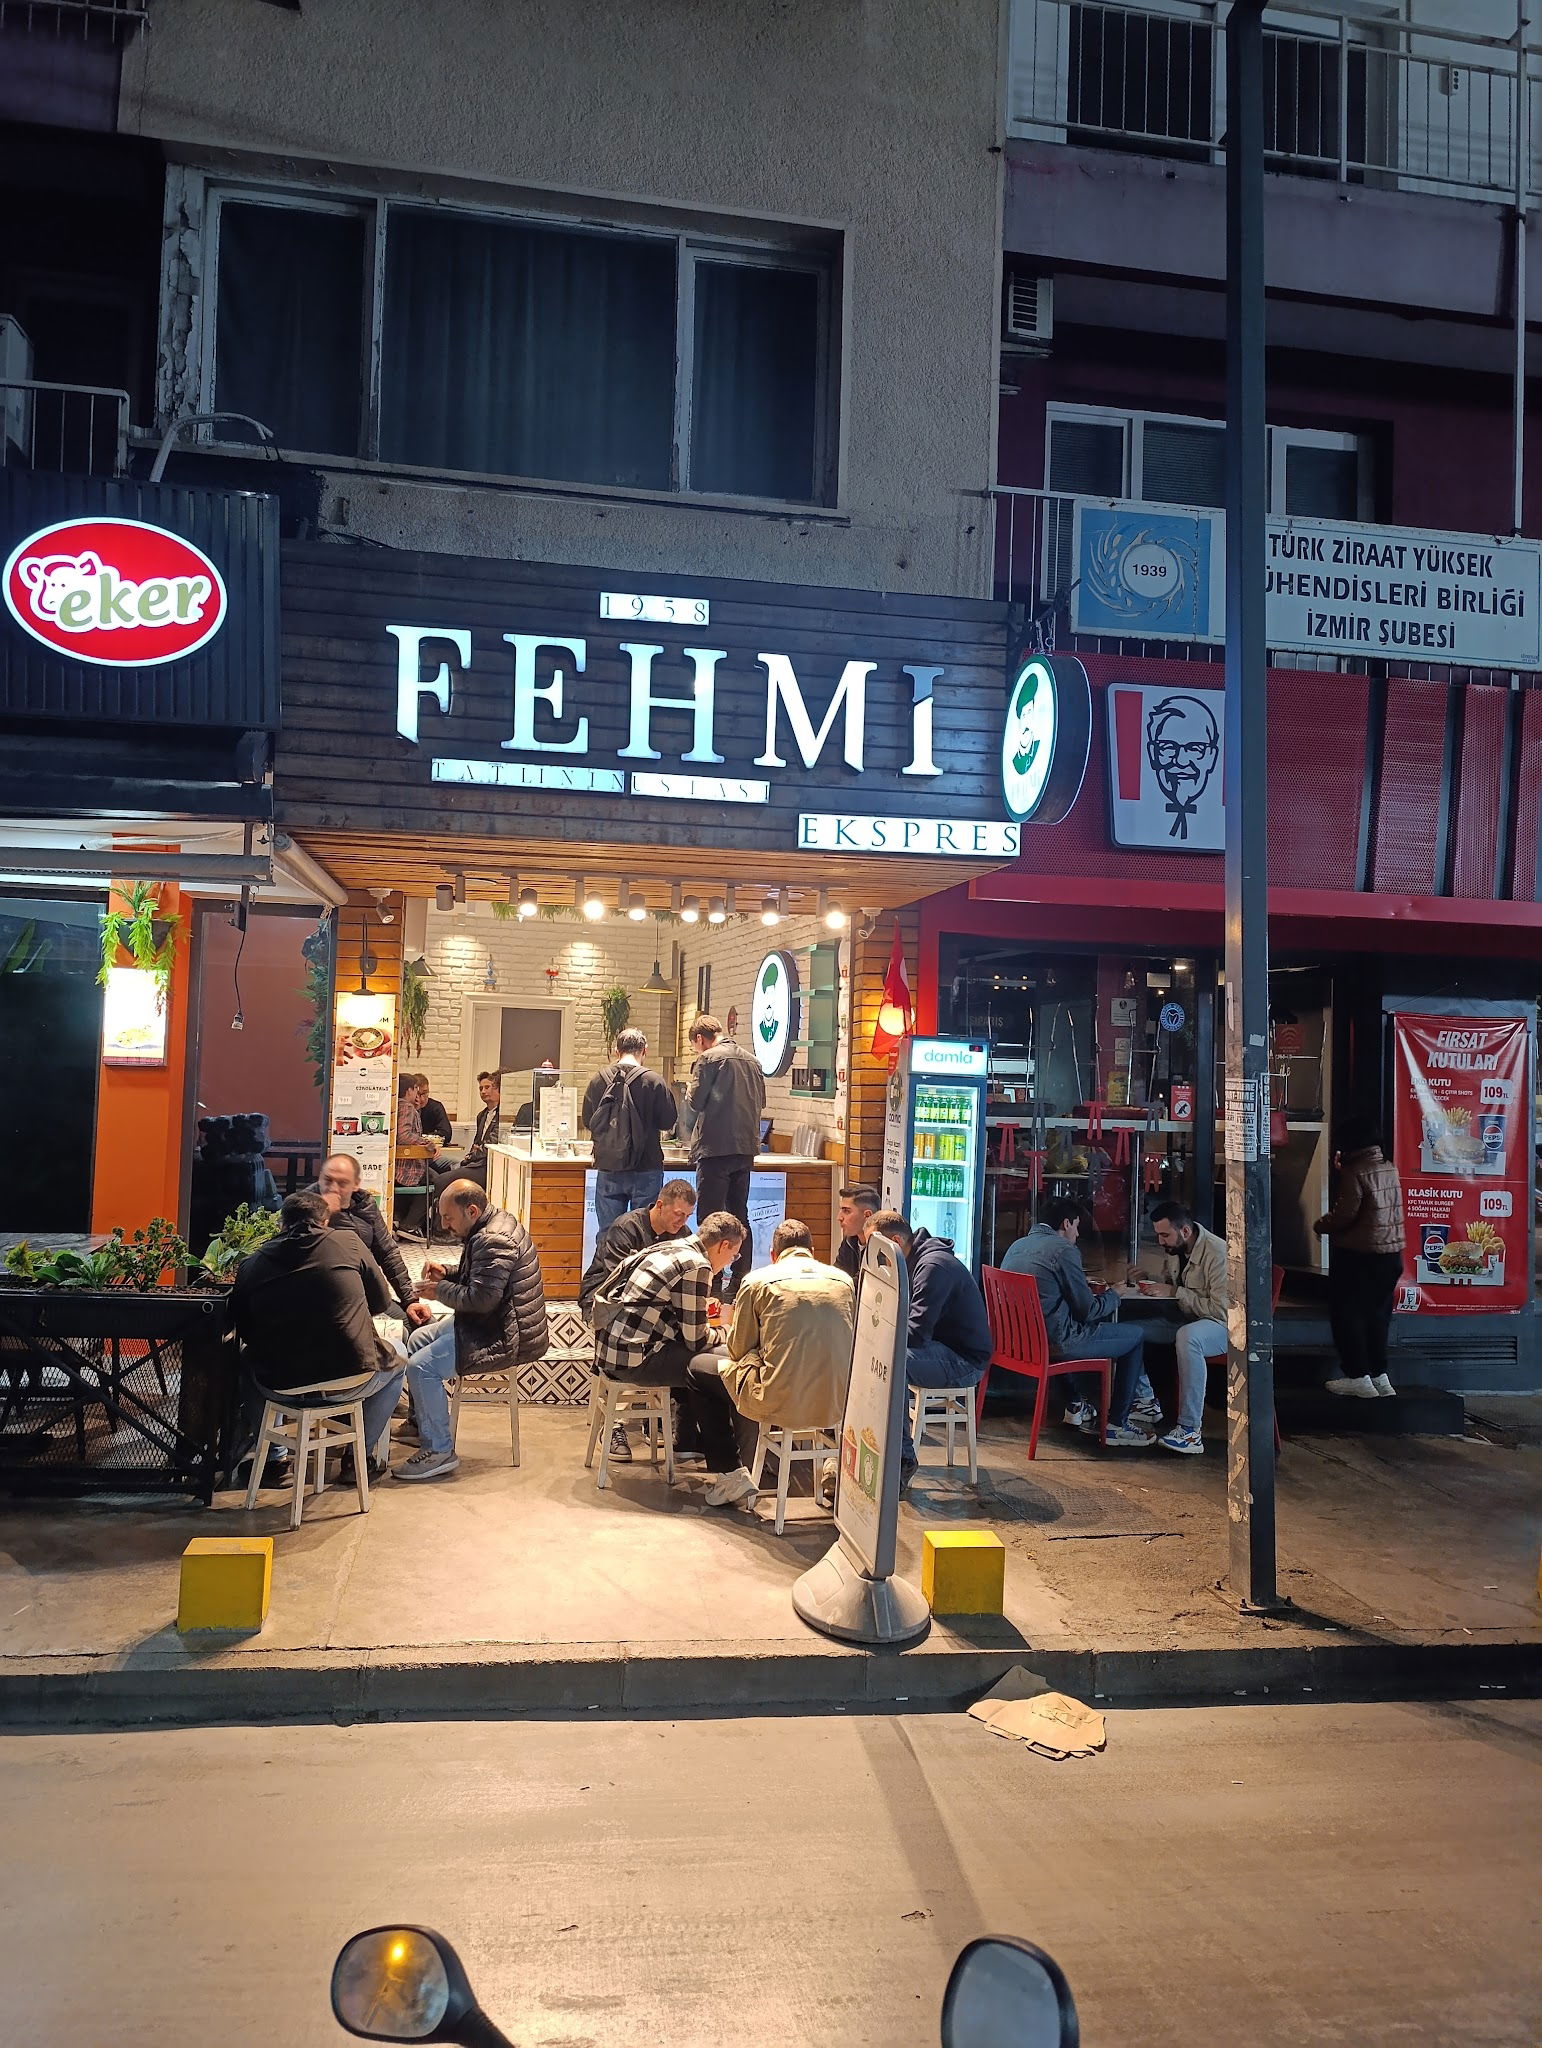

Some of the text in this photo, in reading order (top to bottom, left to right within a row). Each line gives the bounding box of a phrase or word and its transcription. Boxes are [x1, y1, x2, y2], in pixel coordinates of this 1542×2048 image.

[1268, 530, 1493, 579] TÜRK ZİRAAT YÜKSEK
[1132, 563, 1167, 578] 1939
[59, 573, 204, 628] eker
[1265, 566, 1524, 618] ÜHENDİSLERİ BİRLİĞİ
[604, 596, 706, 622] 1958
[1307, 608, 1455, 649] İZMİR ŞUBESİ
[801, 816, 1018, 852] EKSPRES
[1437, 1030, 1489, 1049] FIRSAT
[924, 1049, 973, 1064] damla
[1427, 1051, 1499, 1071] KUTULARI
[1428, 1078, 1452, 1087] KUTU
[1408, 1187, 1463, 1199] KLASİK KUTU
[870, 1356, 888, 1383] SADE
